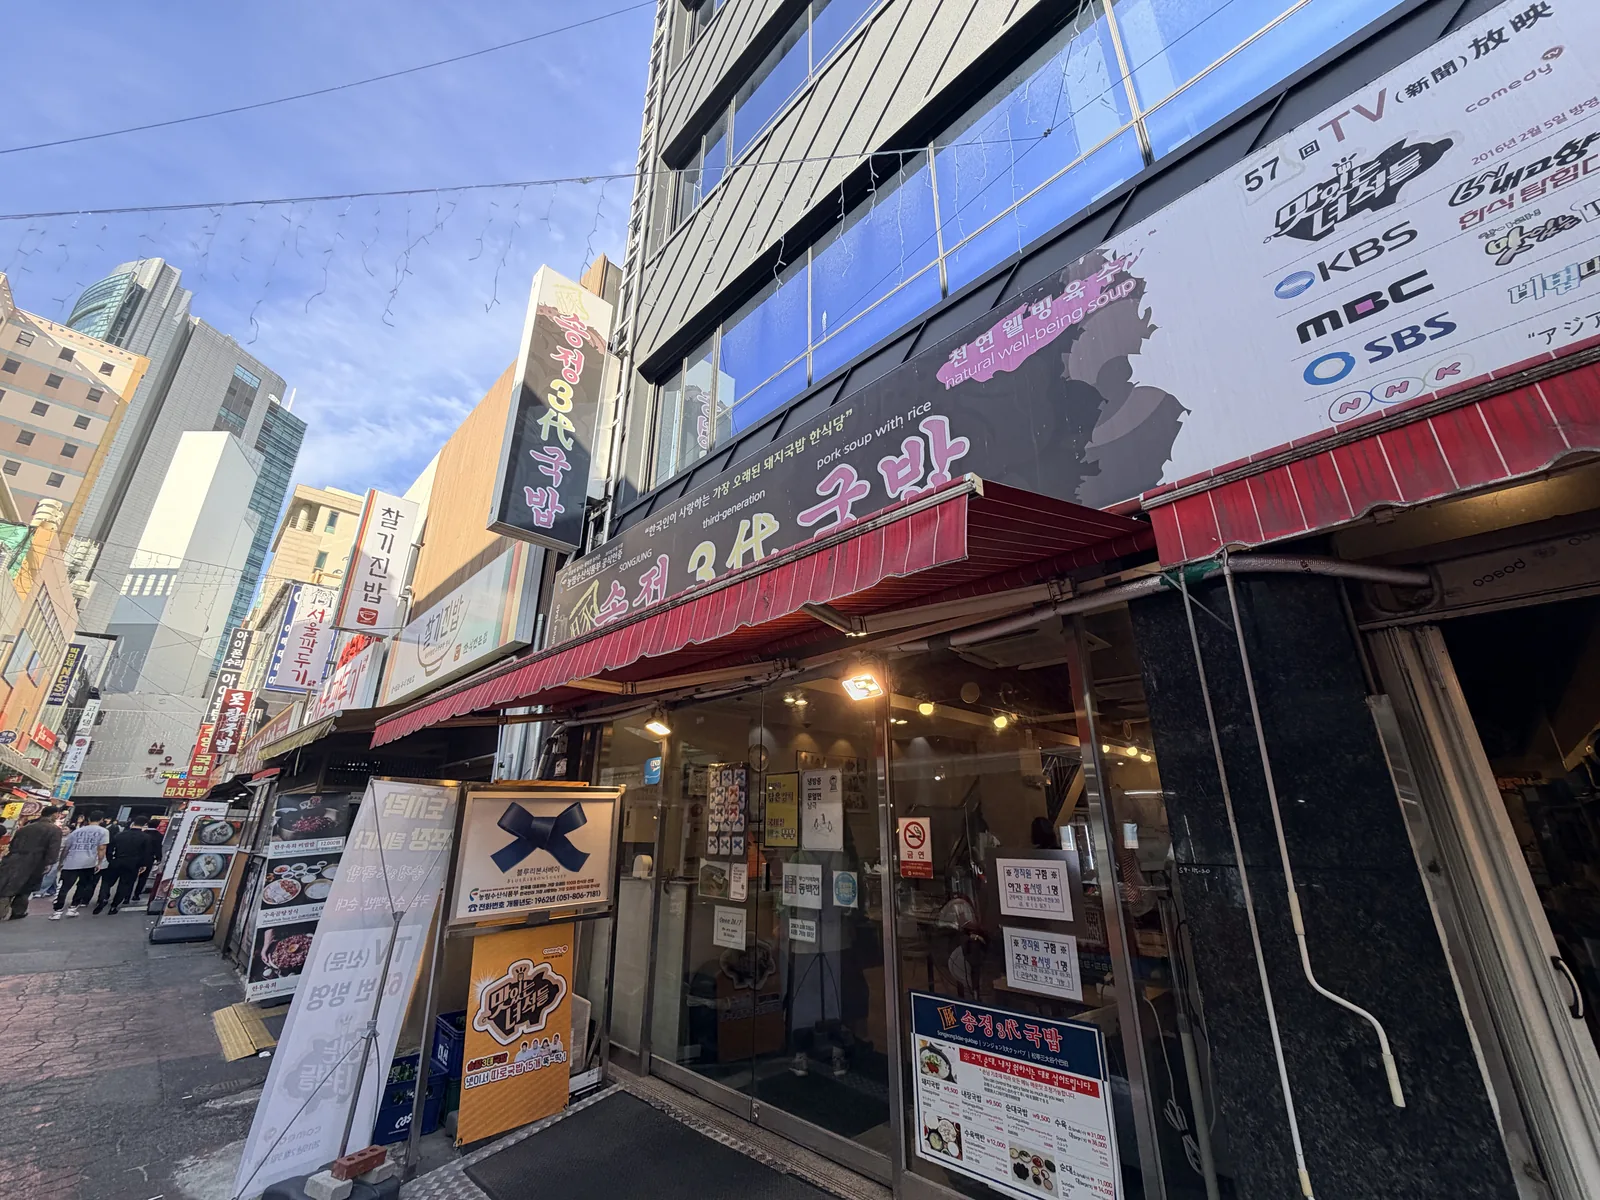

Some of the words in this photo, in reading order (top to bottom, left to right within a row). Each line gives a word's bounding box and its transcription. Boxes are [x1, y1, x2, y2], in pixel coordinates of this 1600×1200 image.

[1465, 63, 1553, 113] comedy
[1244, 157, 1281, 192] 57
[1299, 139, 1321, 161] 回
[1319, 88, 1388, 143] TV
[1471, 137, 1518, 166] 2016년
[1518, 126, 1543, 143] 2월
[1543, 112, 1569, 129] 5일
[1316, 220, 1419, 282] KBS
[1296, 268, 1435, 345] MBC
[945, 353, 995, 390] natural
[997, 304, 1084, 360] well-being
[1087, 277, 1137, 315] soup
[1364, 311, 1457, 364] SBS
[712, 481, 731, 499] 가장
[732, 465, 761, 489] 오래된
[763, 437, 807, 471] 돼지국밥
[618, 548, 653, 574] SONGJUNG
[702, 488, 767, 530] third-generation
[816, 446, 842, 470] pork
[842, 432, 873, 455] soup
[875, 415, 904, 439] with
[906, 400, 933, 422] rice
[363, 505, 405, 605] 찰기진밥
[422, 594, 465, 651] 찰기진밥
[806, 777, 822, 786] 냉방중
[516, 865, 560, 876] 블루리본서베이
[1013, 868, 1032, 879] 정직원
[1034, 869, 1048, 880] 구함
[478, 901, 505, 911] 전화번호
[534, 896, 556, 905] 1962년
[798, 884, 820, 896] 동백전
[1007, 882, 1022, 893] 야간
[1046, 885, 1059, 896] 1명
[1020, 938, 1040, 951] 정직원
[1043, 941, 1057, 954] 구함
[1015, 953, 1029, 964] 주간
[1055, 957, 1068, 973] 1명
[487, 967, 536, 1019] 맛있는
[505, 983, 550, 1031] 녀석들
[960, 1009, 994, 1038] 송정
[1023, 1023, 1063, 1054] 국밥
[490, 1061, 524, 1082] 따로국밥
[921, 1078, 940, 1090] 돼지국밥
[961, 1089, 982, 1103] 내장국밥
[1005, 1103, 1028, 1118] 순대국밥
[1054, 1119, 1067, 1130] 수육
[1060, 1162, 1073, 1175] 순대
